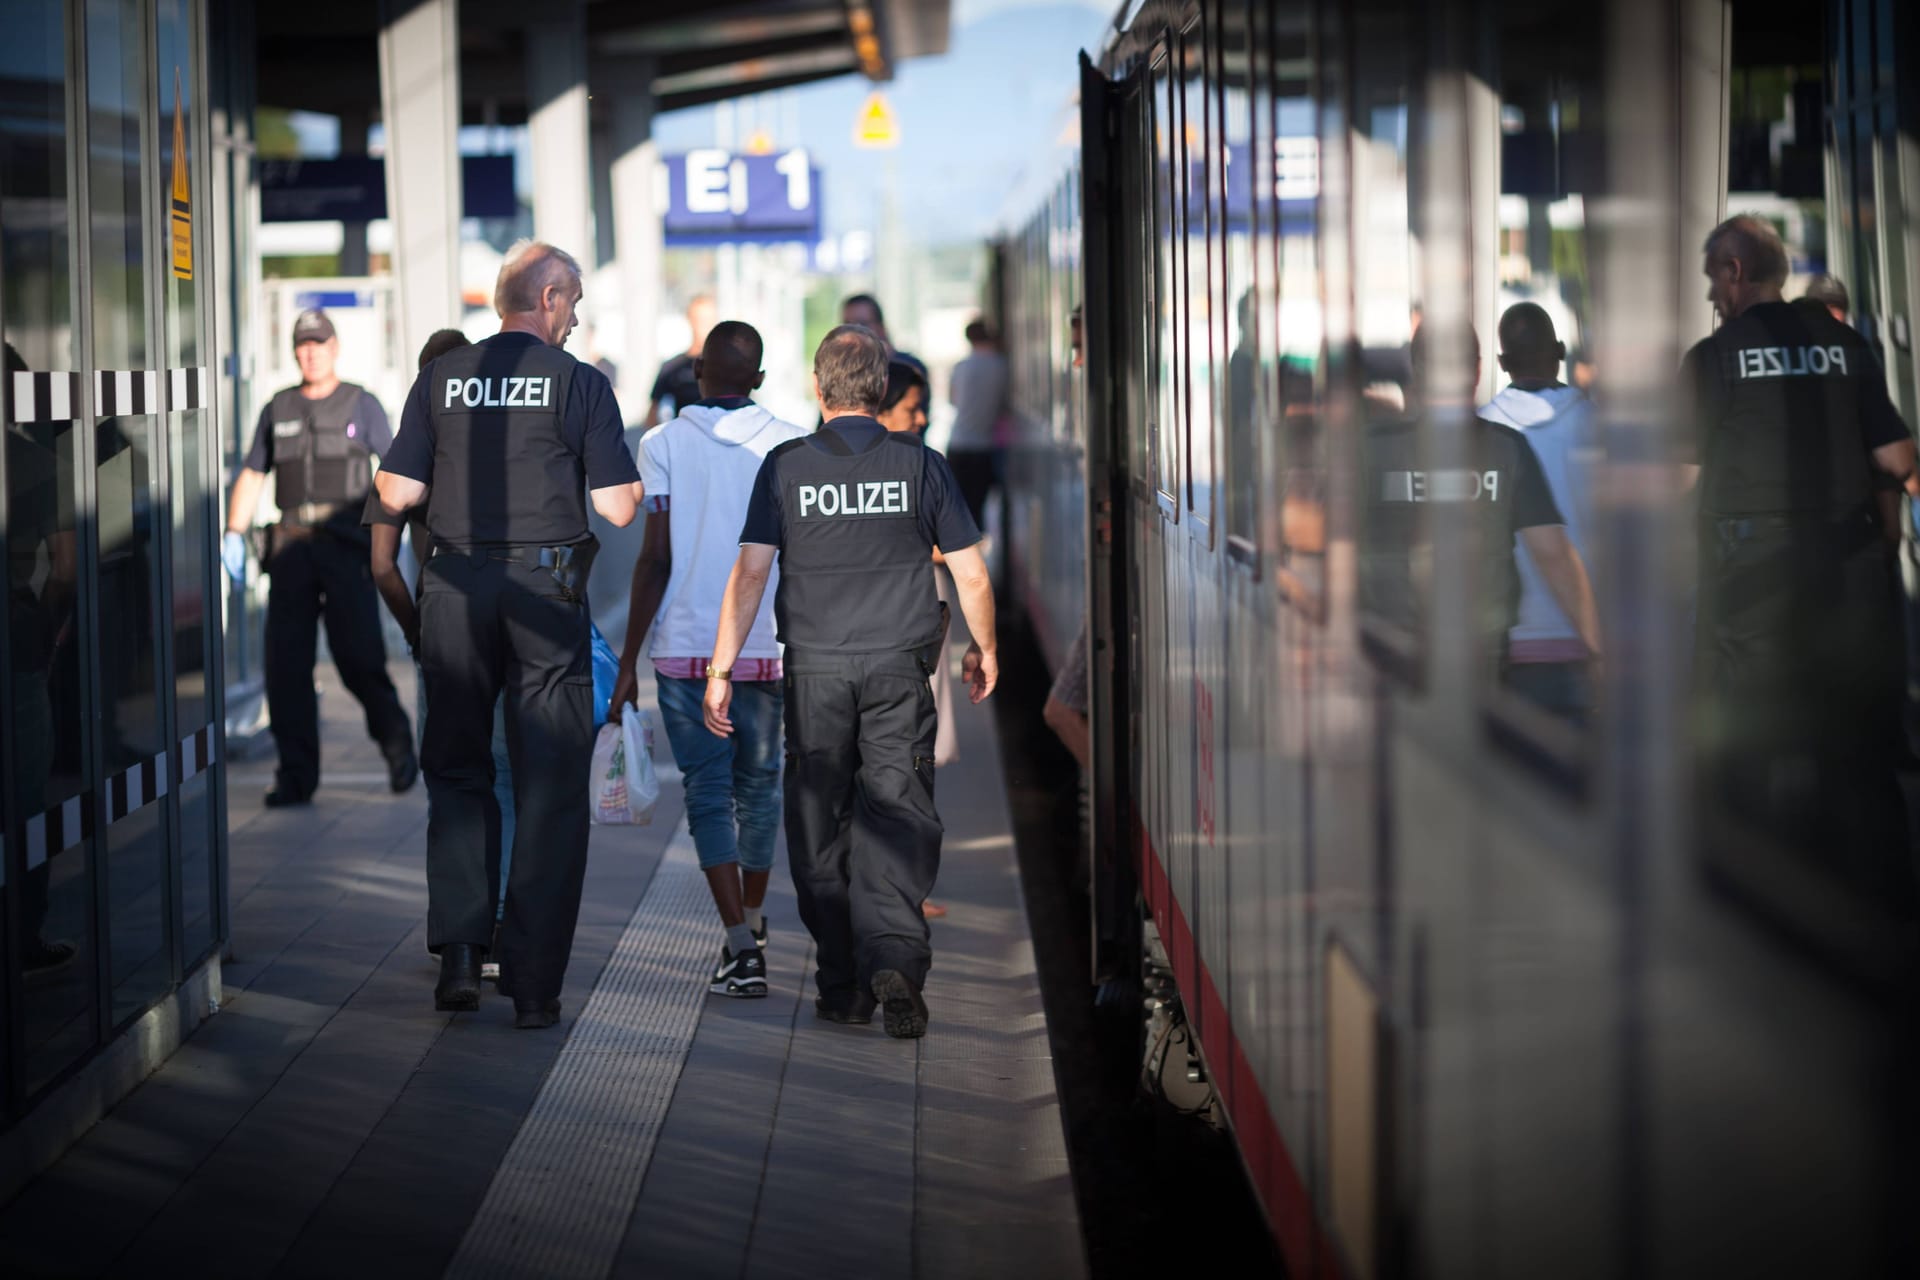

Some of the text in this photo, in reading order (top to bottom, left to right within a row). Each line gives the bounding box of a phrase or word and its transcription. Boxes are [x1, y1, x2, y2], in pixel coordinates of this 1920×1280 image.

[775, 148, 811, 211] 1
[445, 377, 551, 408] POLIZEI
[799, 481, 908, 517] POLIZEI
